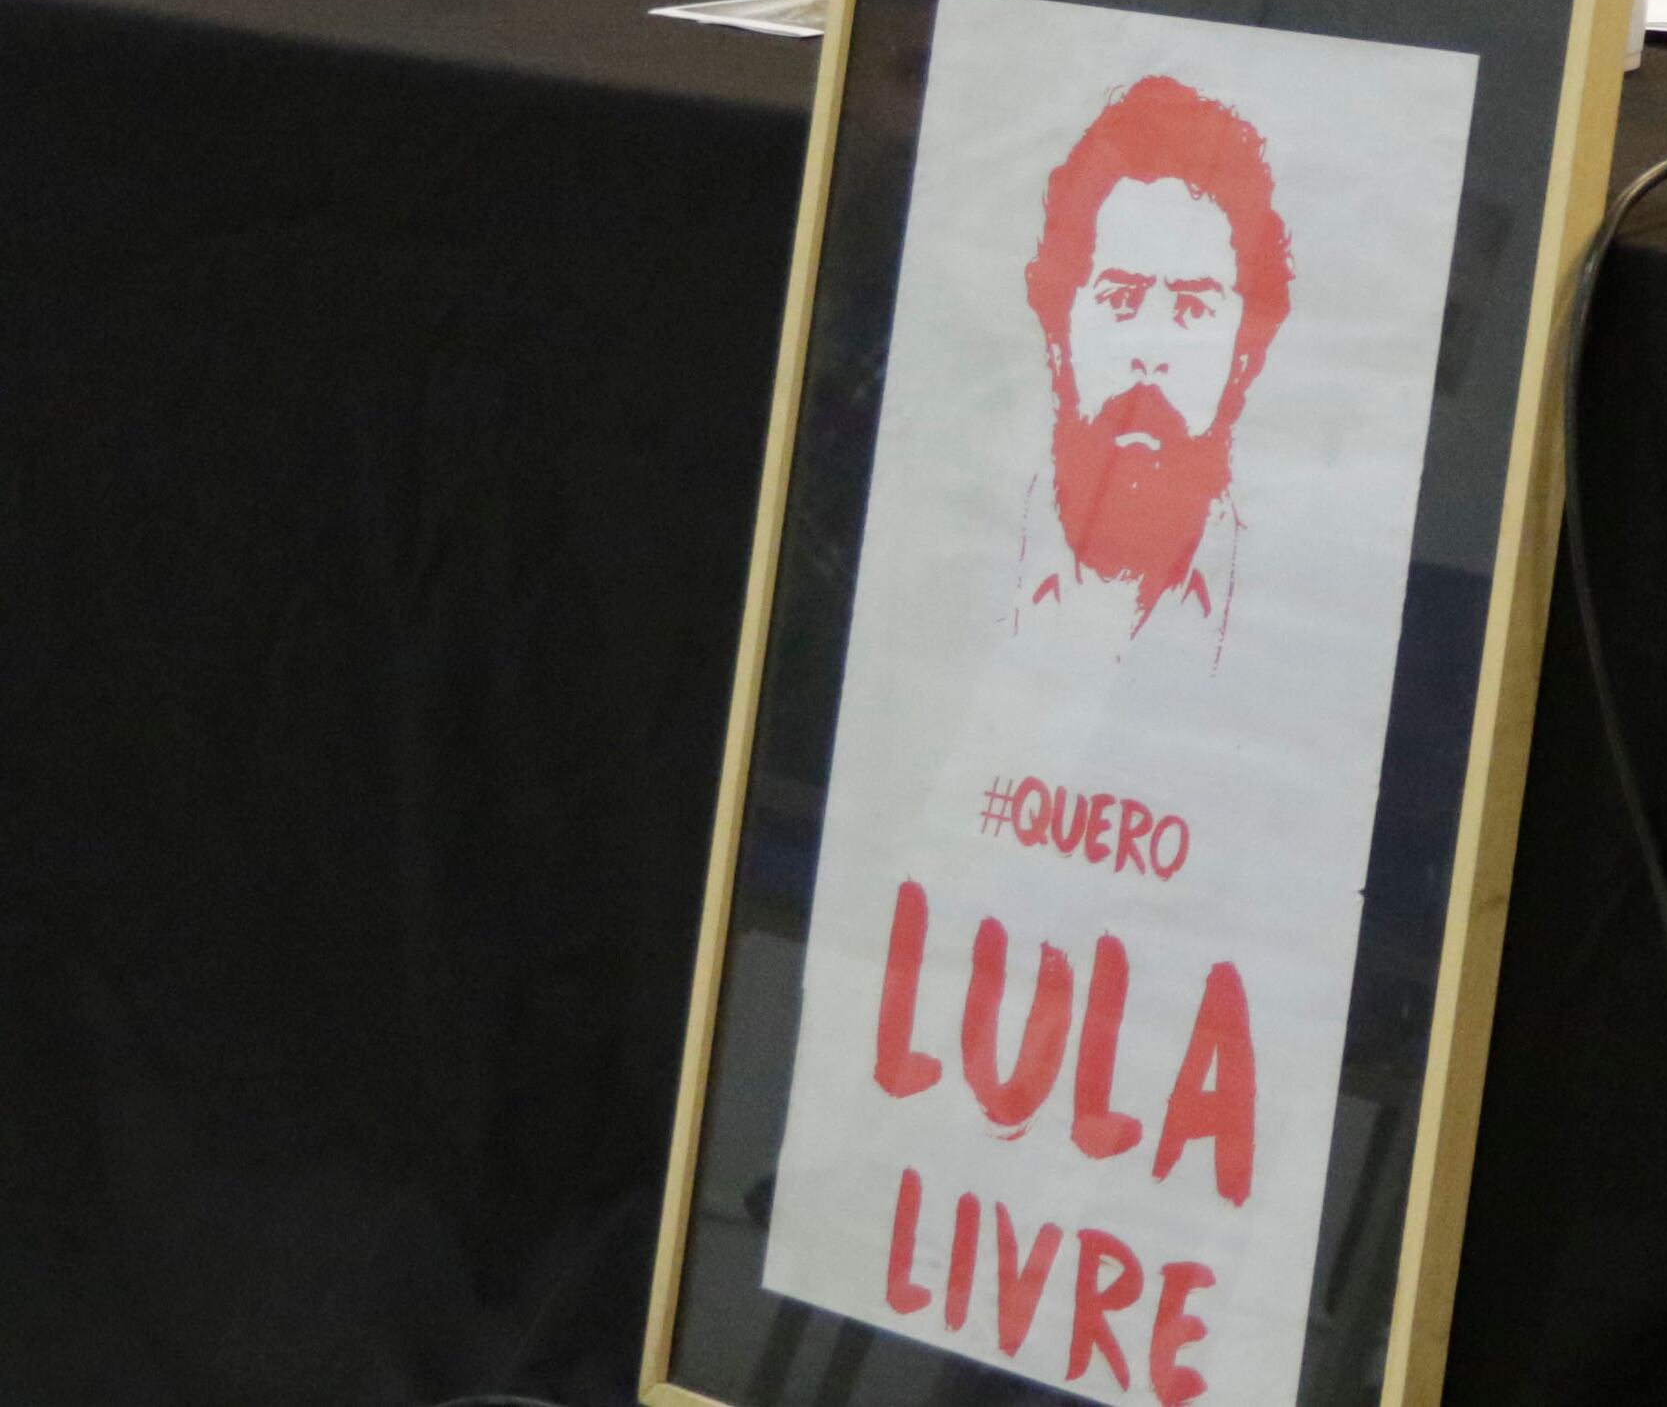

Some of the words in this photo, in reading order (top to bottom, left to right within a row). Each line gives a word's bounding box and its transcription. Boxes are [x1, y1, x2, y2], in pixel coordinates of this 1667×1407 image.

[980, 775, 1190, 881] #QUERO
[874, 875, 1257, 1208] LULA
[885, 1167, 1216, 1407] LIVRE
